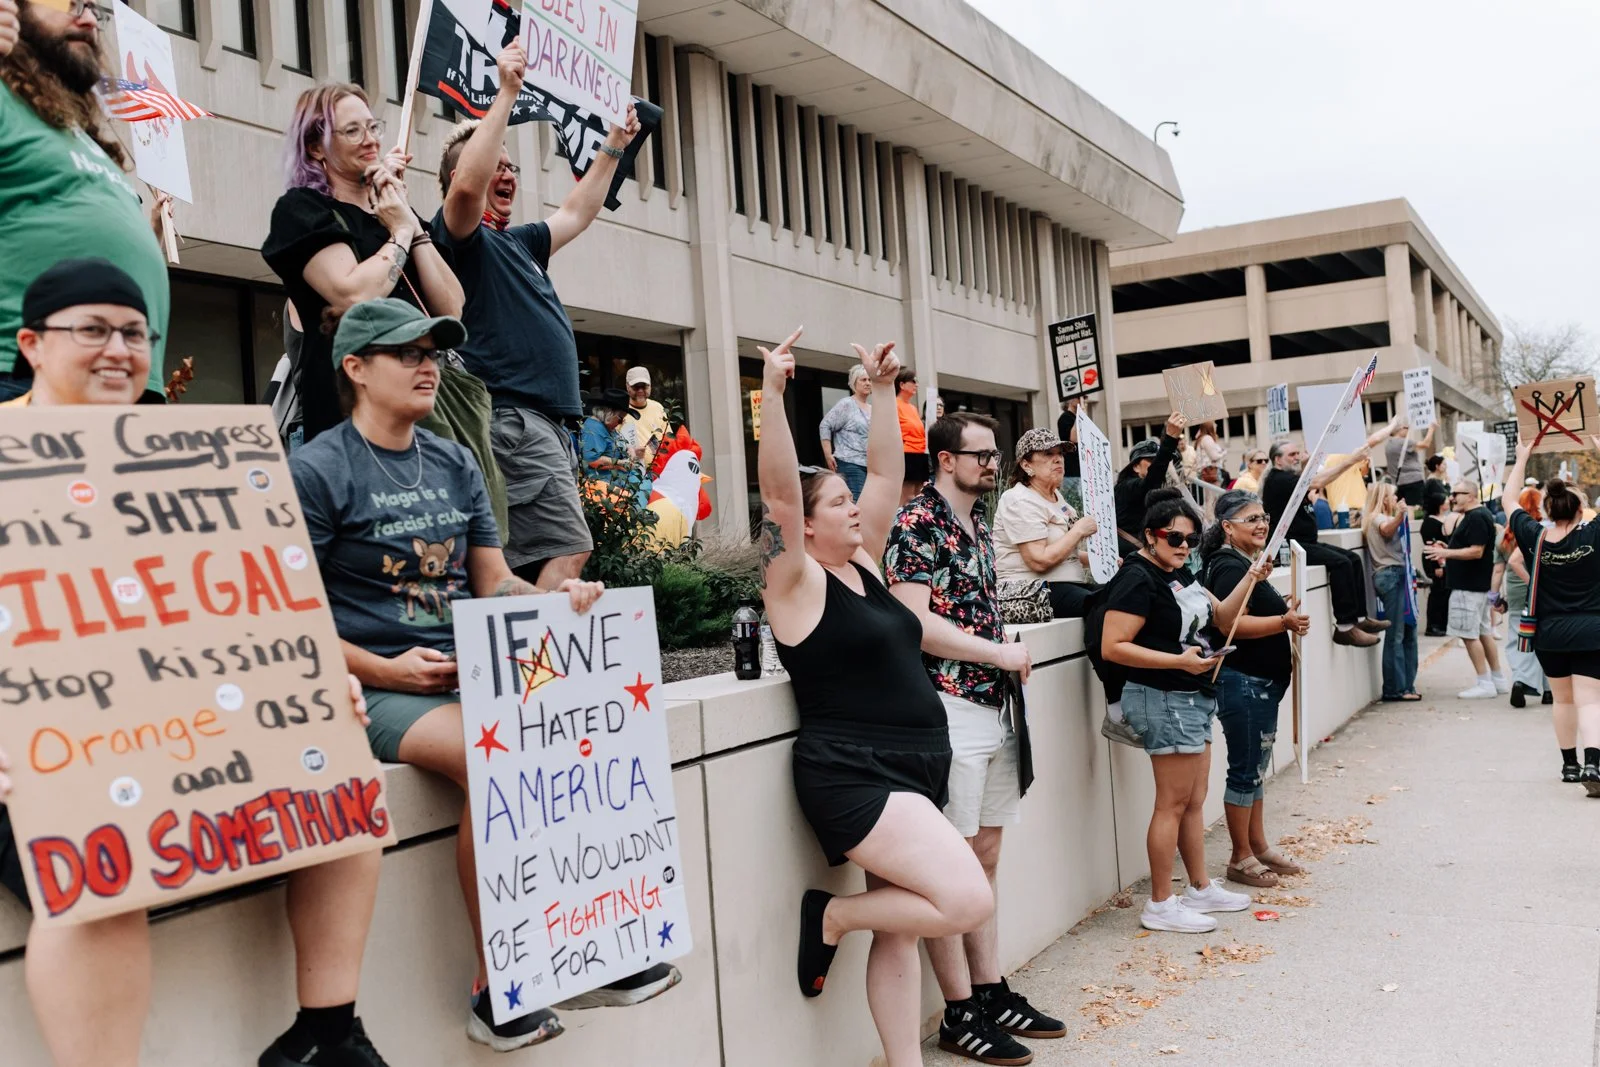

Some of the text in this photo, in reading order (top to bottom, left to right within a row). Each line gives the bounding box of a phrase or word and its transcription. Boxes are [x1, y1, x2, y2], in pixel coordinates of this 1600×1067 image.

[541, 0, 617, 54] ES IN
[446, 67, 456, 80] If
[471, 91, 497, 105] Like
[526, 17, 621, 114] DARKNESS
[1055, 328, 1093, 345] Different Hat.
[1058, 320, 1088, 335] Same Shit.
[0, 412, 274, 470] ear Congress
[112, 486, 242, 535] SHIT
[264, 499, 297, 529] is
[371, 486, 449, 509] Maga is a
[374, 507, 469, 538] fascist cult
[0, 544, 323, 648] ILLEGAL
[138, 632, 321, 683] kissing
[486, 609, 622, 699] IF WE
[28, 688, 335, 775] Orange ass
[517, 700, 625, 752] HATED
[172, 750, 253, 797] and
[484, 756, 655, 845] AMERICA
[28, 776, 389, 918] DO SOMETHING
[484, 855, 538, 903] WE
[487, 875, 662, 971] BE FIGHTING
[551, 914, 650, 989] FOR IT!
